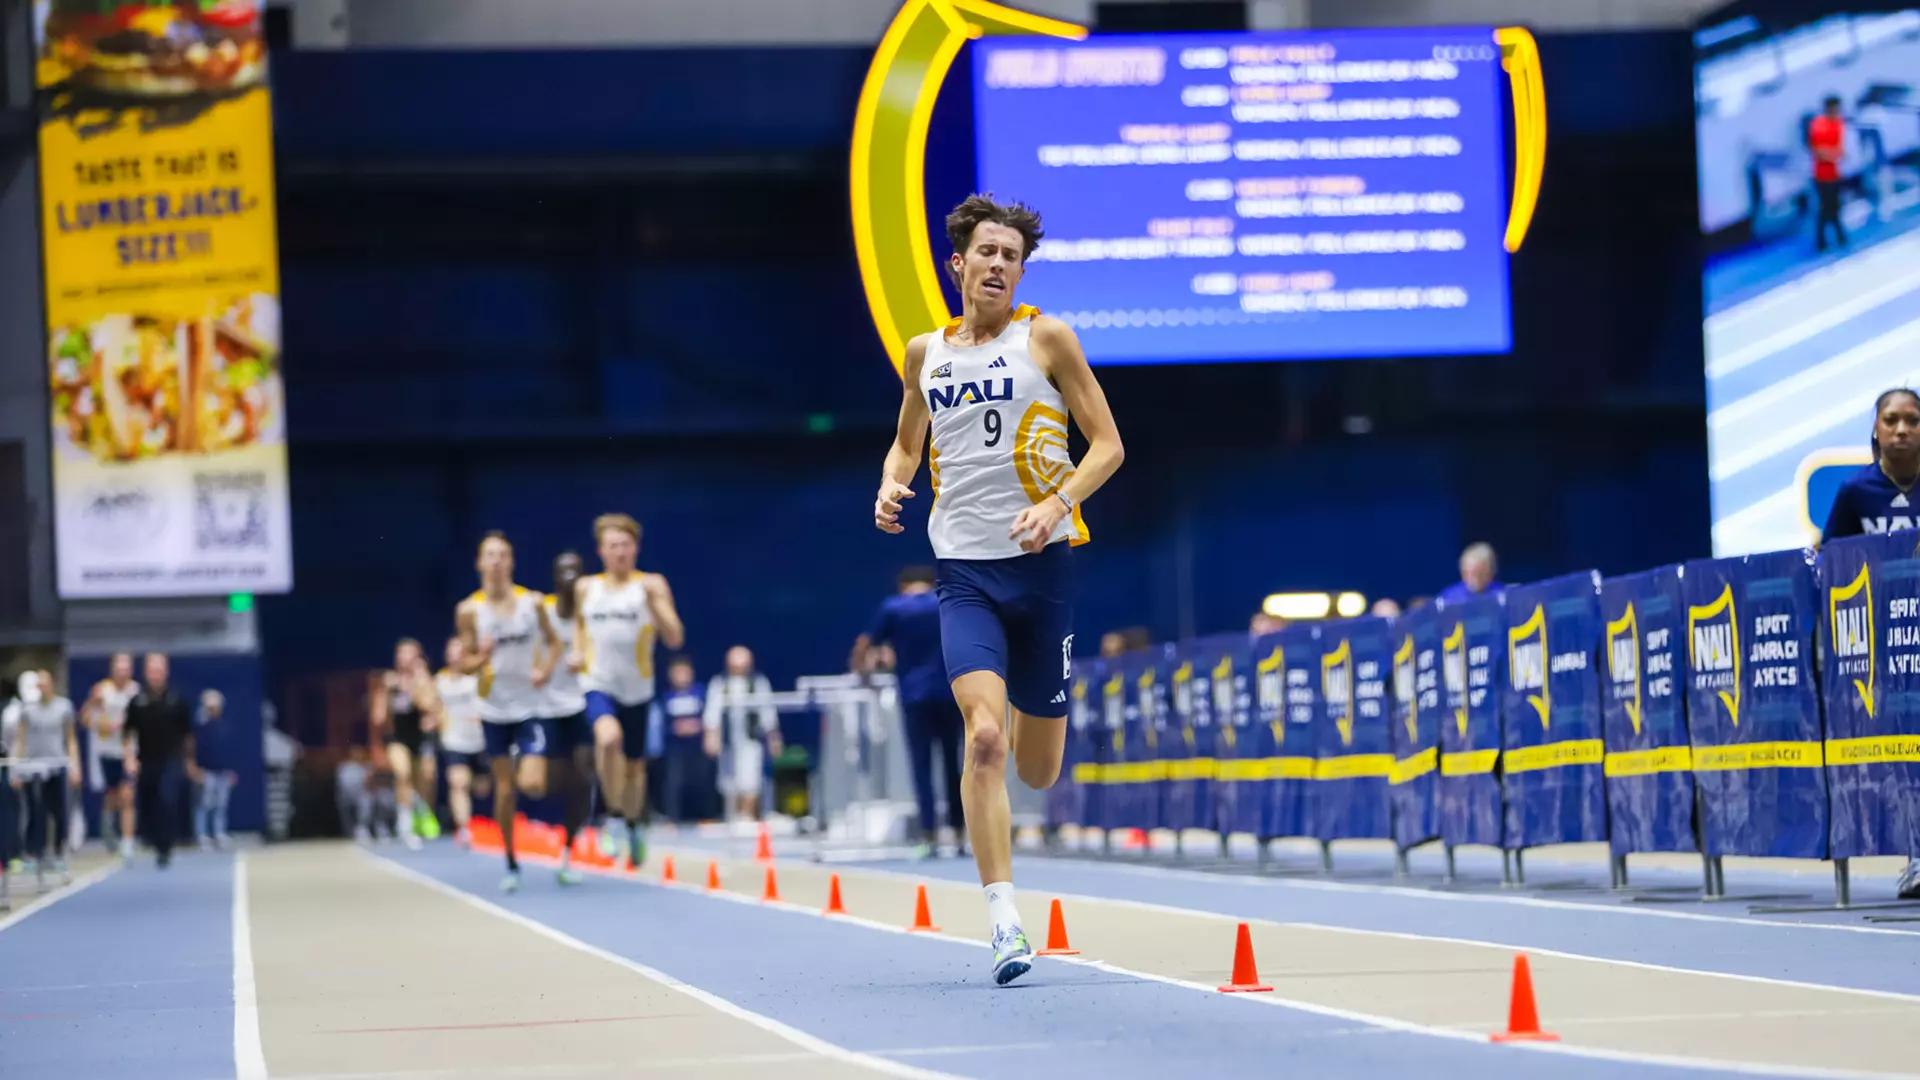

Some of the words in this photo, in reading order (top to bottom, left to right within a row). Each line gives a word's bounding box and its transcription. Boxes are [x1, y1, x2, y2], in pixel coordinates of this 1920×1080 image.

[928, 377, 1014, 413] NAU
[983, 408, 1003, 448] 9
[1694, 623, 1732, 672] NAU
[1836, 605, 1868, 658] NAU
